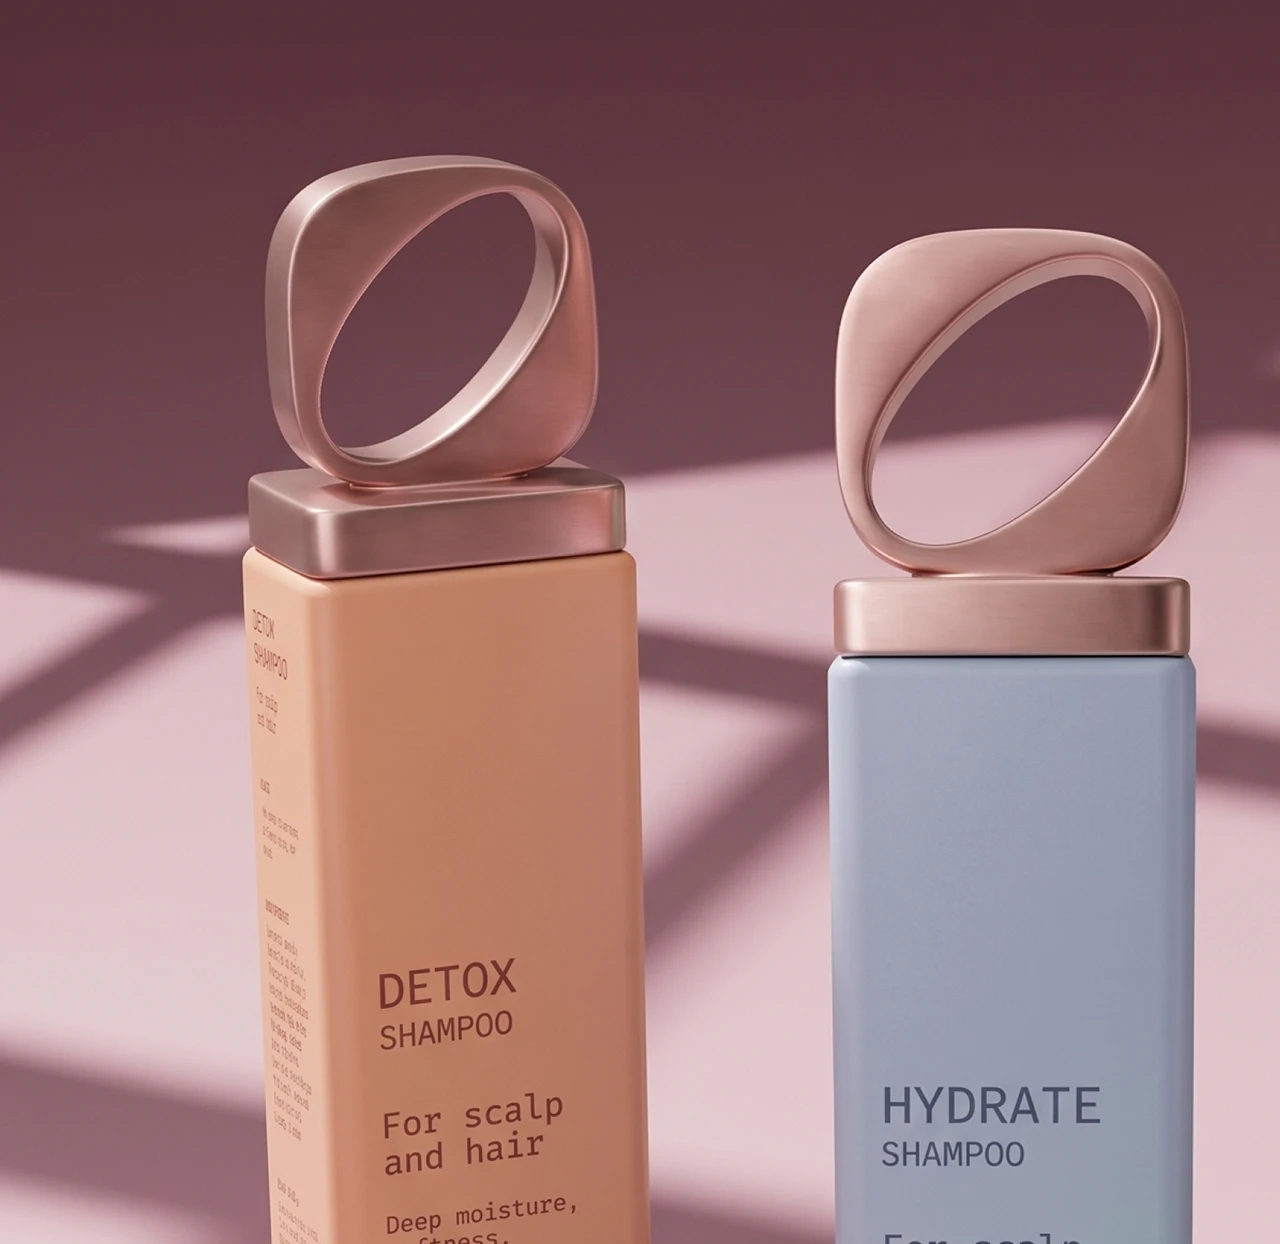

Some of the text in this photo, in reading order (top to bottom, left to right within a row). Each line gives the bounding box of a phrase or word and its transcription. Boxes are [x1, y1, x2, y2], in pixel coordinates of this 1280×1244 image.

[378, 957, 518, 1010] DETOX
[379, 1010, 514, 1051] SHAMPOO
[383, 1092, 564, 1139] For scalp
[883, 1086, 1101, 1124] HYDRATE
[384, 1130, 544, 1176] and hair
[881, 1141, 1025, 1167] SHAMPOO
[386, 1196, 577, 1235] Deep moisture,
